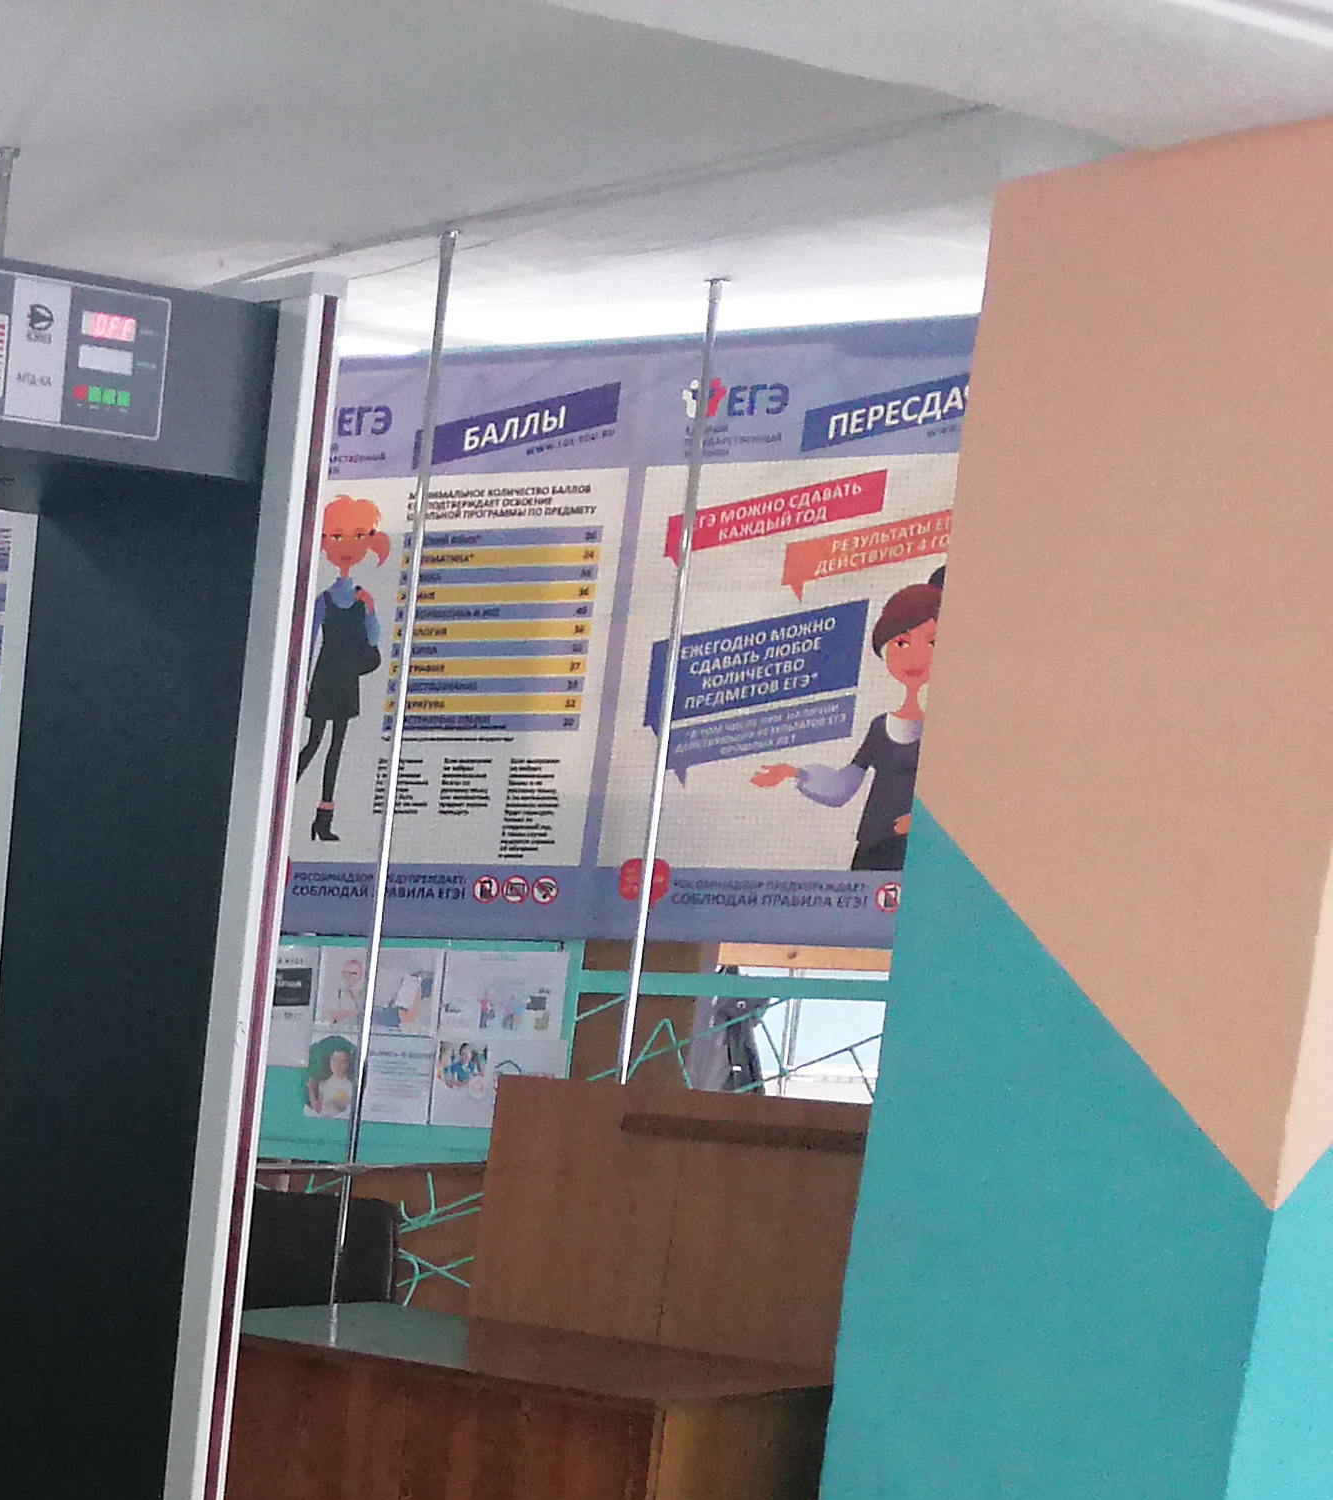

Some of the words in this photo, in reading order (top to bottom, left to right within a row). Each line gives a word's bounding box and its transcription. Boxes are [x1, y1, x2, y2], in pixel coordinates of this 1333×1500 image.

[727, 383, 790, 416] ЕГЭ
[828, 384, 970, 440] ПЕРЕСДА
[338, 405, 393, 436] ЕГЭ
[463, 405, 567, 452] БАЛЛЫ
[693, 513, 717, 530] ГЭ
[720, 498, 785, 524] МОЖНО
[789, 482, 862, 510] СДАВАТЬ
[718, 512, 792, 542] КАЖДЫЙ
[796, 506, 828, 524] ГОД
[832, 520, 931, 553] РЕЗУЛЬТАТЫ
[814, 542, 914, 577] ДЕЙСТВУЮТ
[680, 632, 767, 660] ЕЖЕГОДНО
[770, 617, 836, 642] МОЖНО
[690, 650, 760, 675] СДАВАТЬ
[763, 637, 823, 661] ЛЮБОЕ
[702, 658, 805, 690] КОЛИЧЕСТВО
[685, 680, 780, 711] ПРЕДМЕТОВ
[292, 883, 368, 899] СОБЛЮДАЙ
